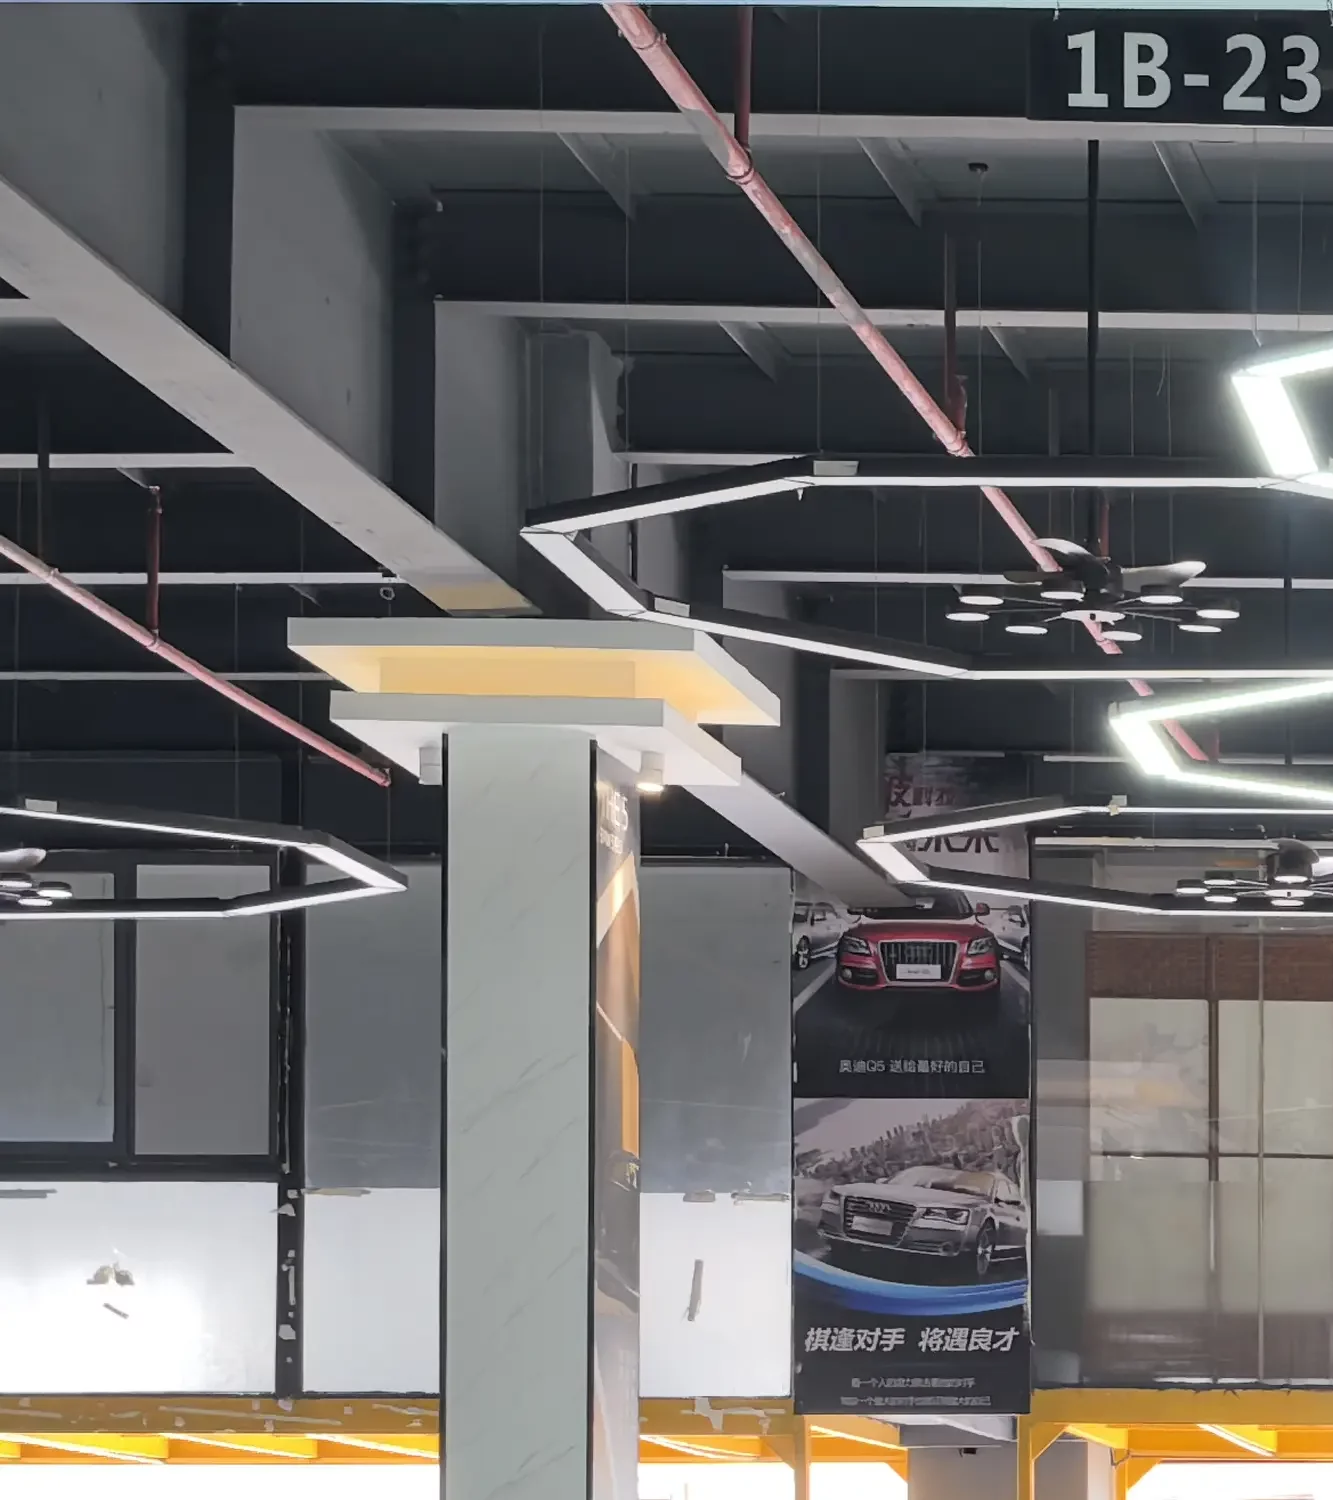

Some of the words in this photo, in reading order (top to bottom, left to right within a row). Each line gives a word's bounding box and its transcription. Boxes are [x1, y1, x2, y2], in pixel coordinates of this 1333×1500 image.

[1066, 29, 1322, 114] 1B-23
[804, 1327, 905, 1352] 棋逢对手
[918, 1327, 1019, 1352] 将遇良才
